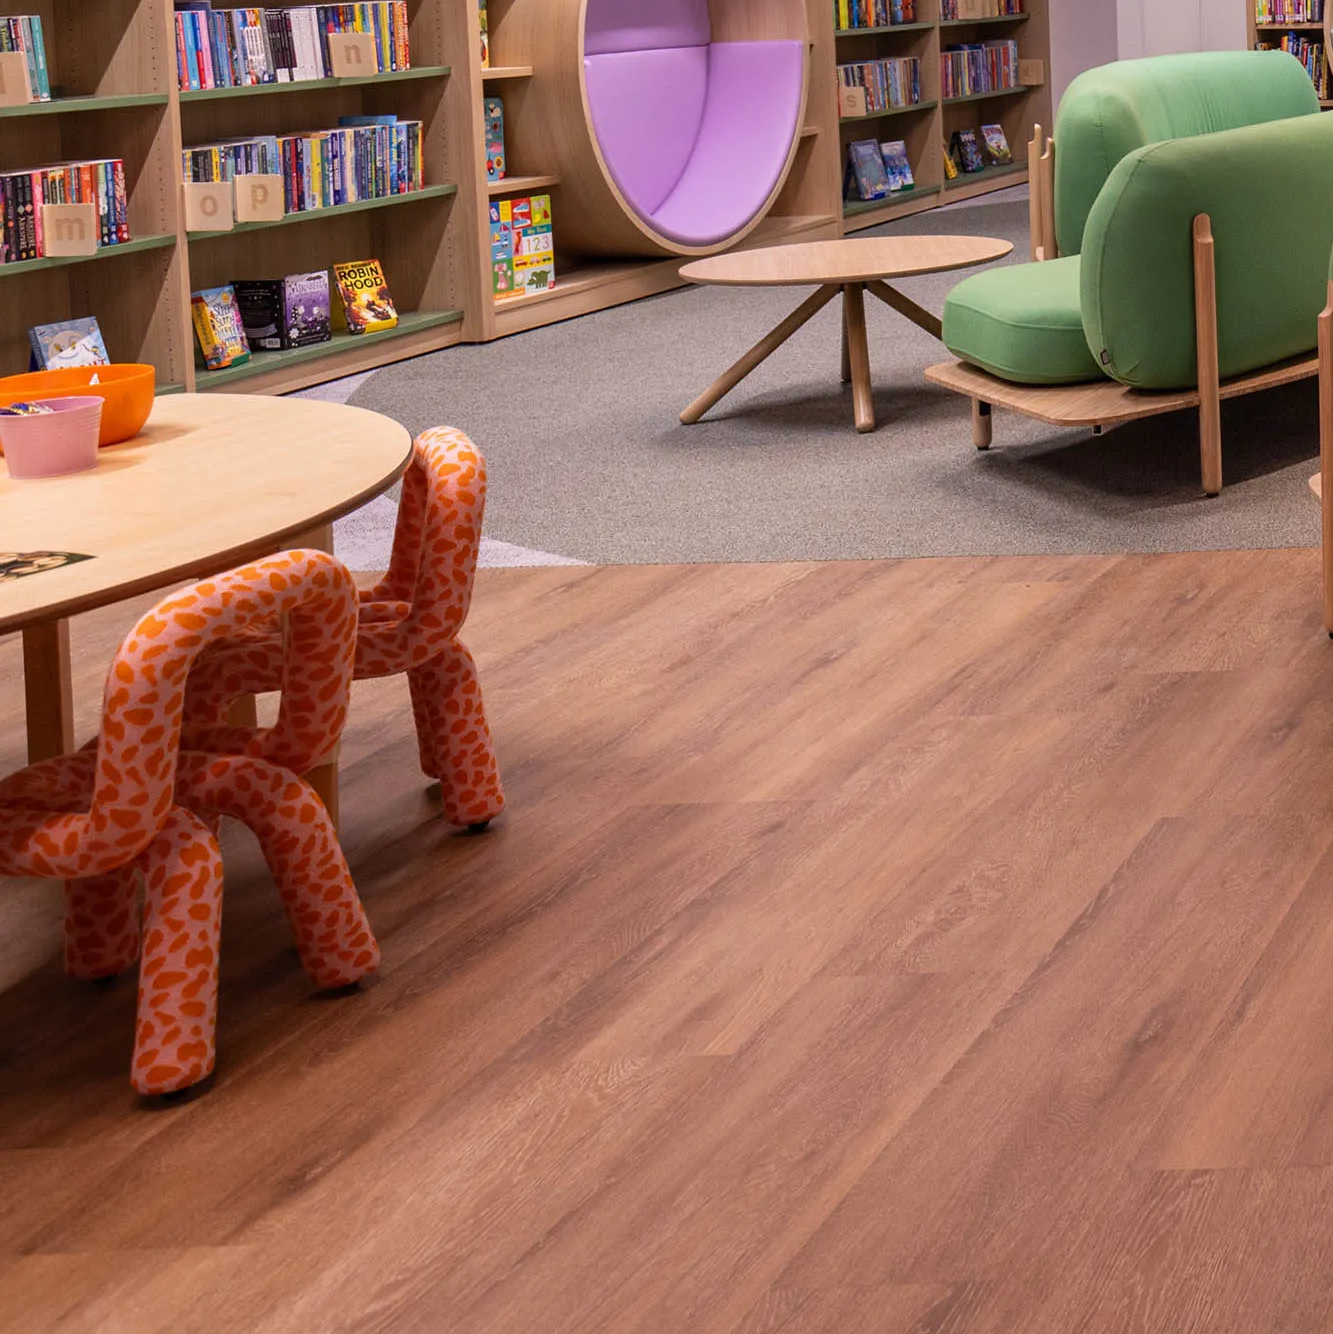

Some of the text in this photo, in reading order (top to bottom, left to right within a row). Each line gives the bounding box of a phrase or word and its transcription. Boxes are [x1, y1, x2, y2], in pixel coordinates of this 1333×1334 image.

[343, 44, 363, 65] n
[55, 217, 86, 241] m
[338, 266, 380, 281] ROBIN
[344, 276, 383, 291] HOOD
